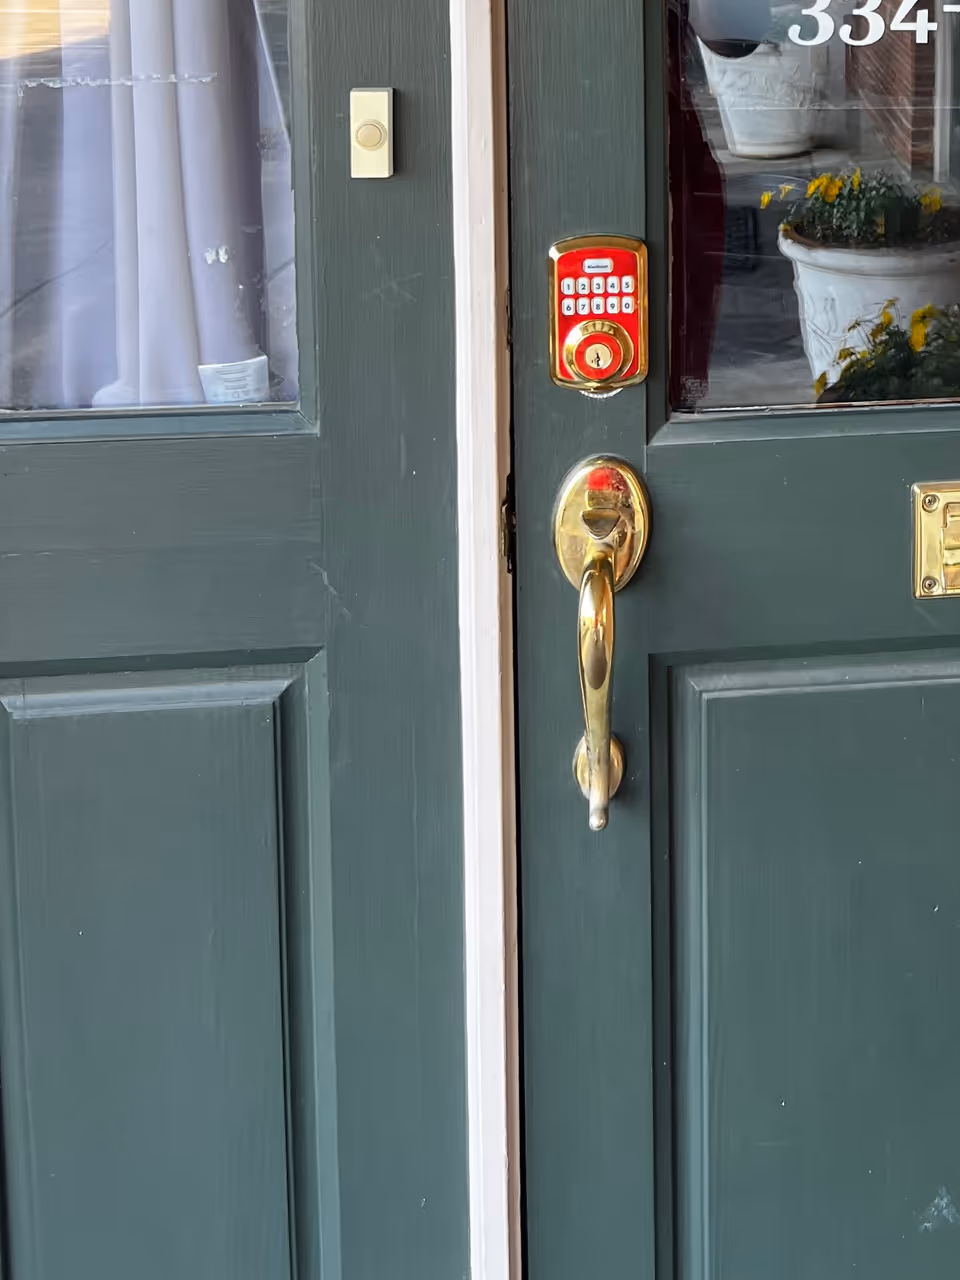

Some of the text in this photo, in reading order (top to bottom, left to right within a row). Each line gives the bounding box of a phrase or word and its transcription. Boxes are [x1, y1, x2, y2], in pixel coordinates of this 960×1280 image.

[567, 283, 571, 291] 1
[580, 283, 586, 291] 2
[595, 282, 601, 290] 3
[624, 281, 630, 289] 5
[595, 303, 601, 311] 8
[624, 302, 630, 310] 0
